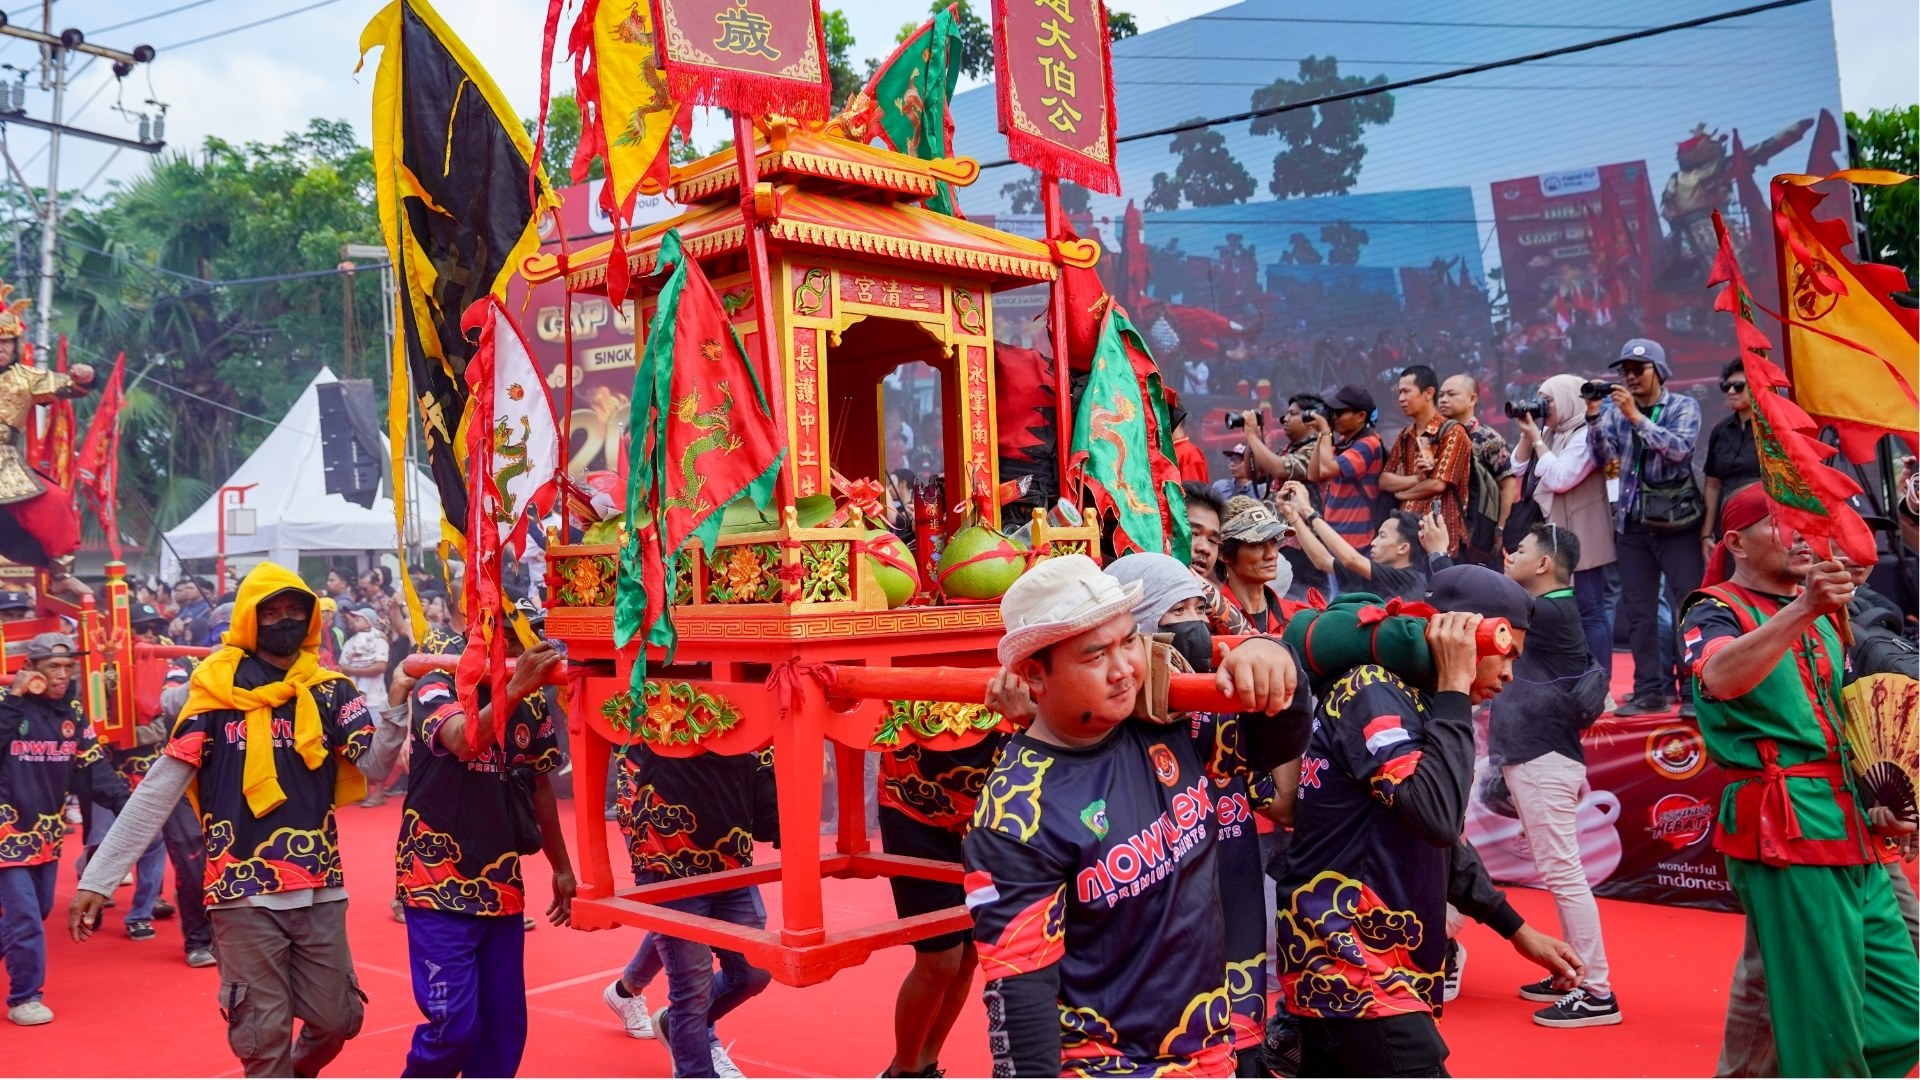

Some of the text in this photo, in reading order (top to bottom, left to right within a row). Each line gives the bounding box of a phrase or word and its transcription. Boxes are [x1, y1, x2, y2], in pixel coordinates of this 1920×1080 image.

[713, 0, 781, 61] 歲
[595, 347, 635, 365] SINGK
[1658, 861, 1717, 875] wonderful
[1658, 872, 1732, 891] indonesi
